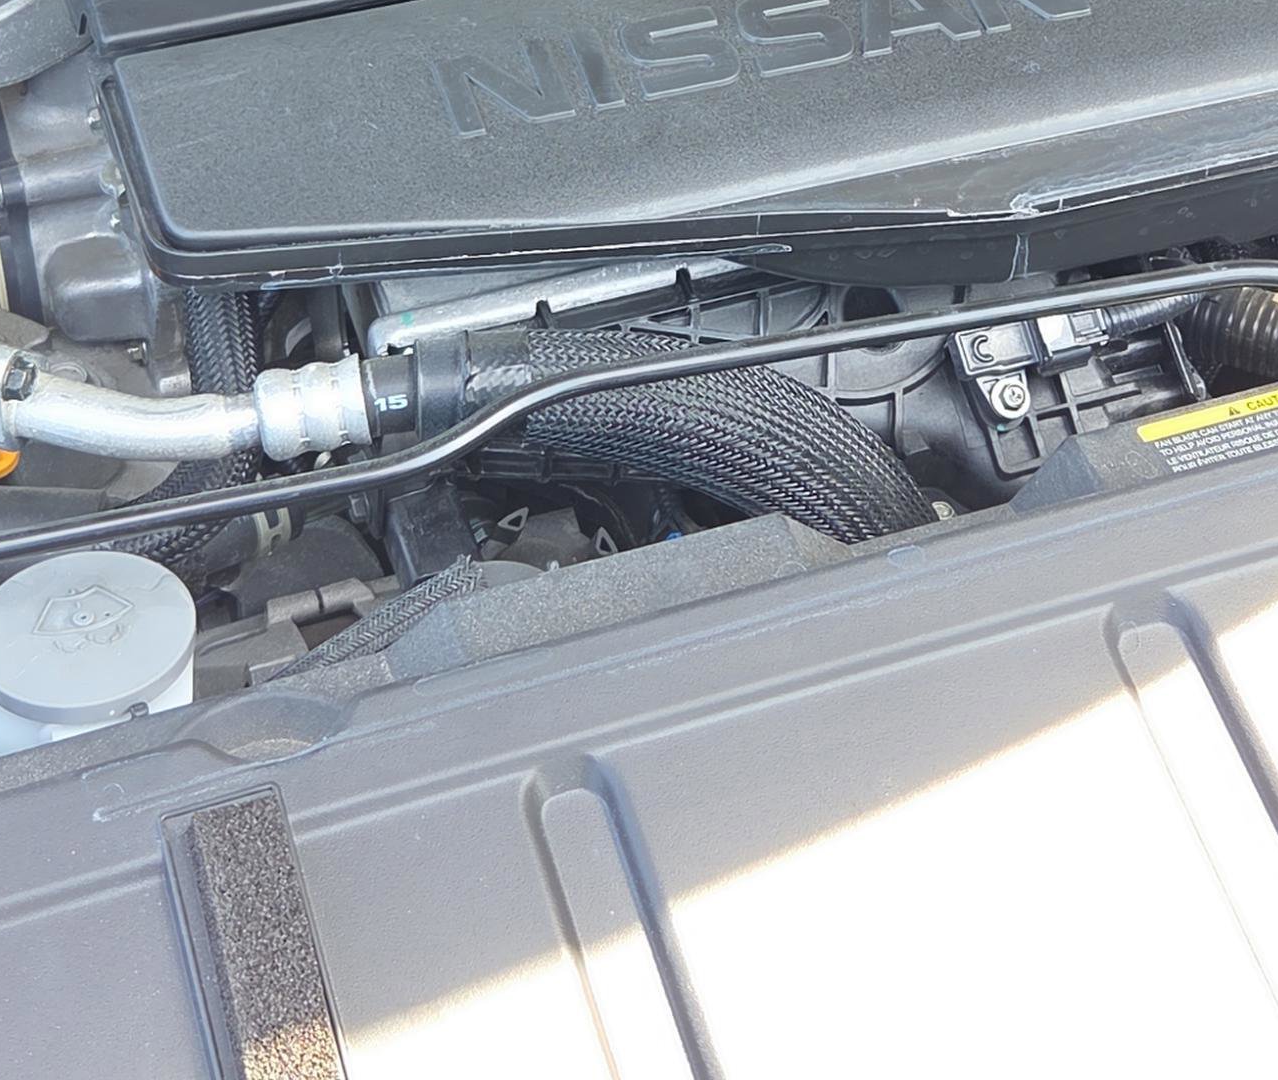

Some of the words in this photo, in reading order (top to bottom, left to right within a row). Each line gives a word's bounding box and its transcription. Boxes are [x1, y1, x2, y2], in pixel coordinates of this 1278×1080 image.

[971, 333, 995, 363] C
[374, 394, 409, 412] 15
[1155, 439, 1172, 448] FAN
[1172, 432, 1199, 443] BLADE
[1200, 426, 1219, 436] CAN
[1219, 420, 1244, 430] START
[1160, 448, 1173, 456] TO
[1173, 441, 1195, 453] HELP
[1195, 435, 1221, 446] AVOID
[1220, 423, 1265, 438] PERSONAL
